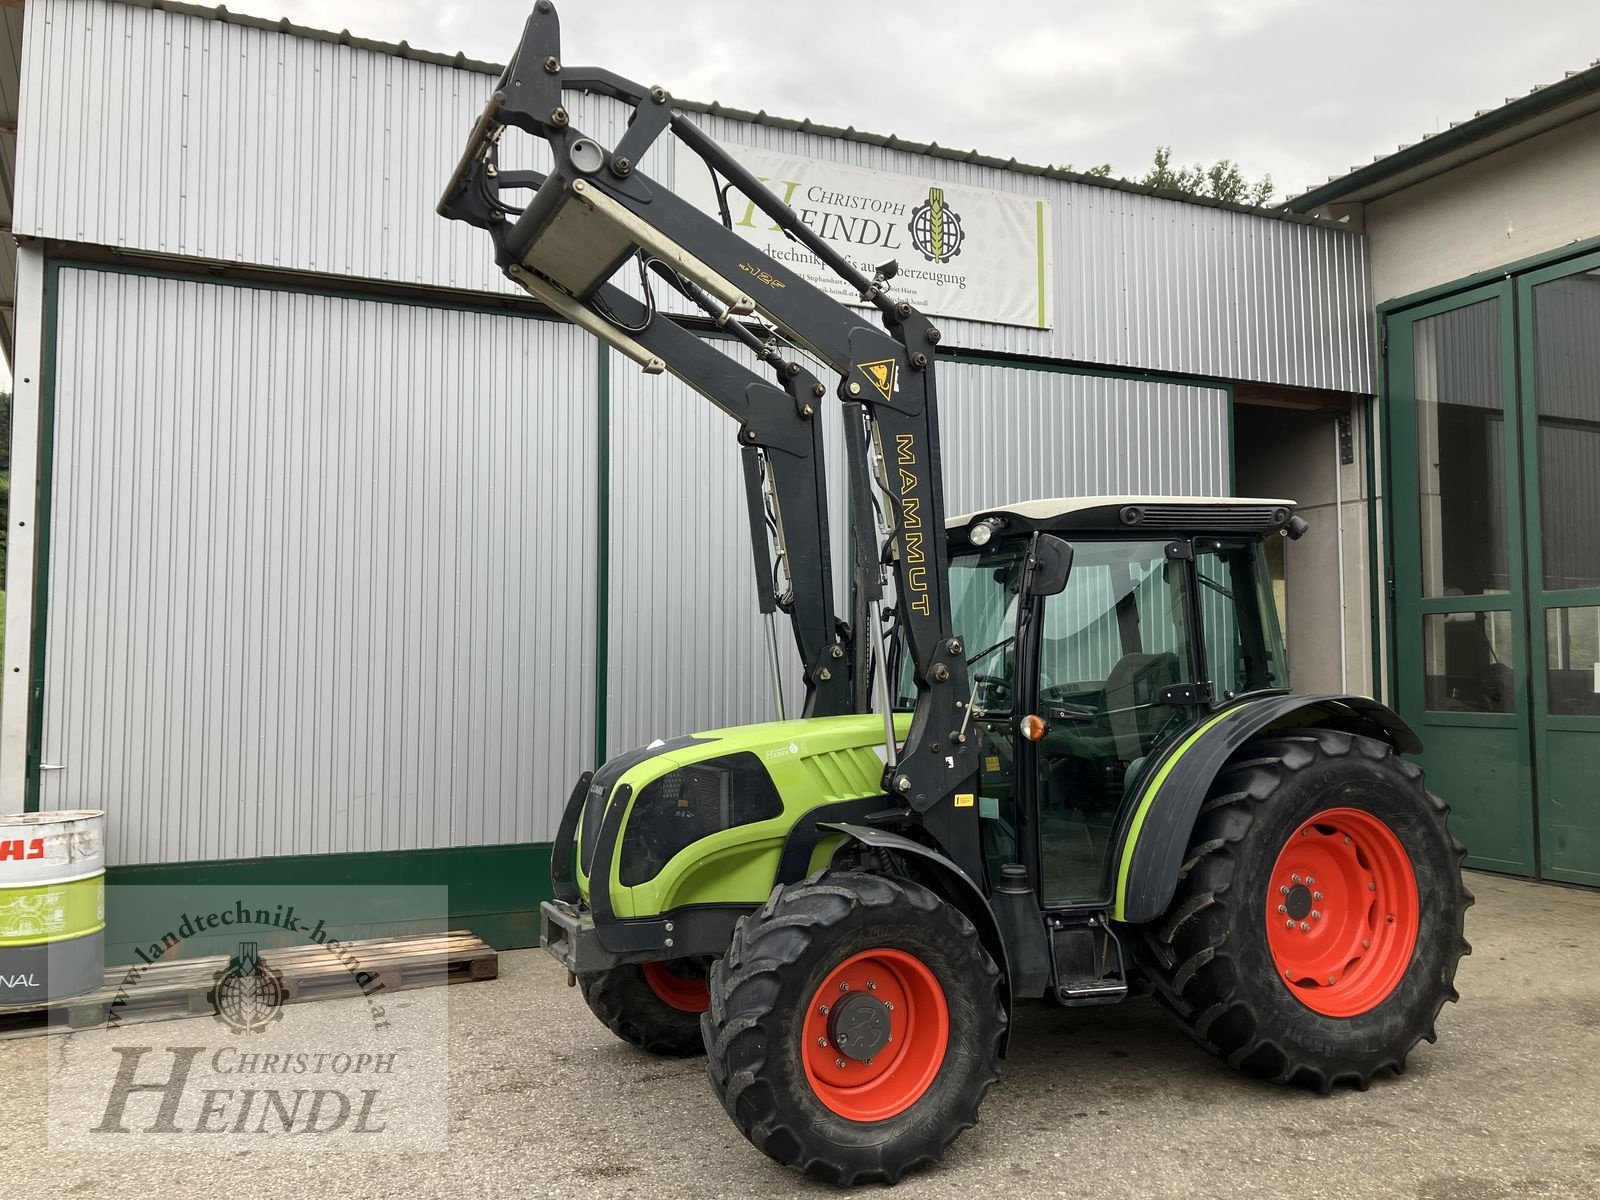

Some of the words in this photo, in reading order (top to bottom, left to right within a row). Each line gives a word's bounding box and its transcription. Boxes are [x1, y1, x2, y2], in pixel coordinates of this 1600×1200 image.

[807, 185, 906, 216] CHRISTOPH
[896, 262, 966, 289] berzeugung
[896, 434, 930, 616] MAMMUT
